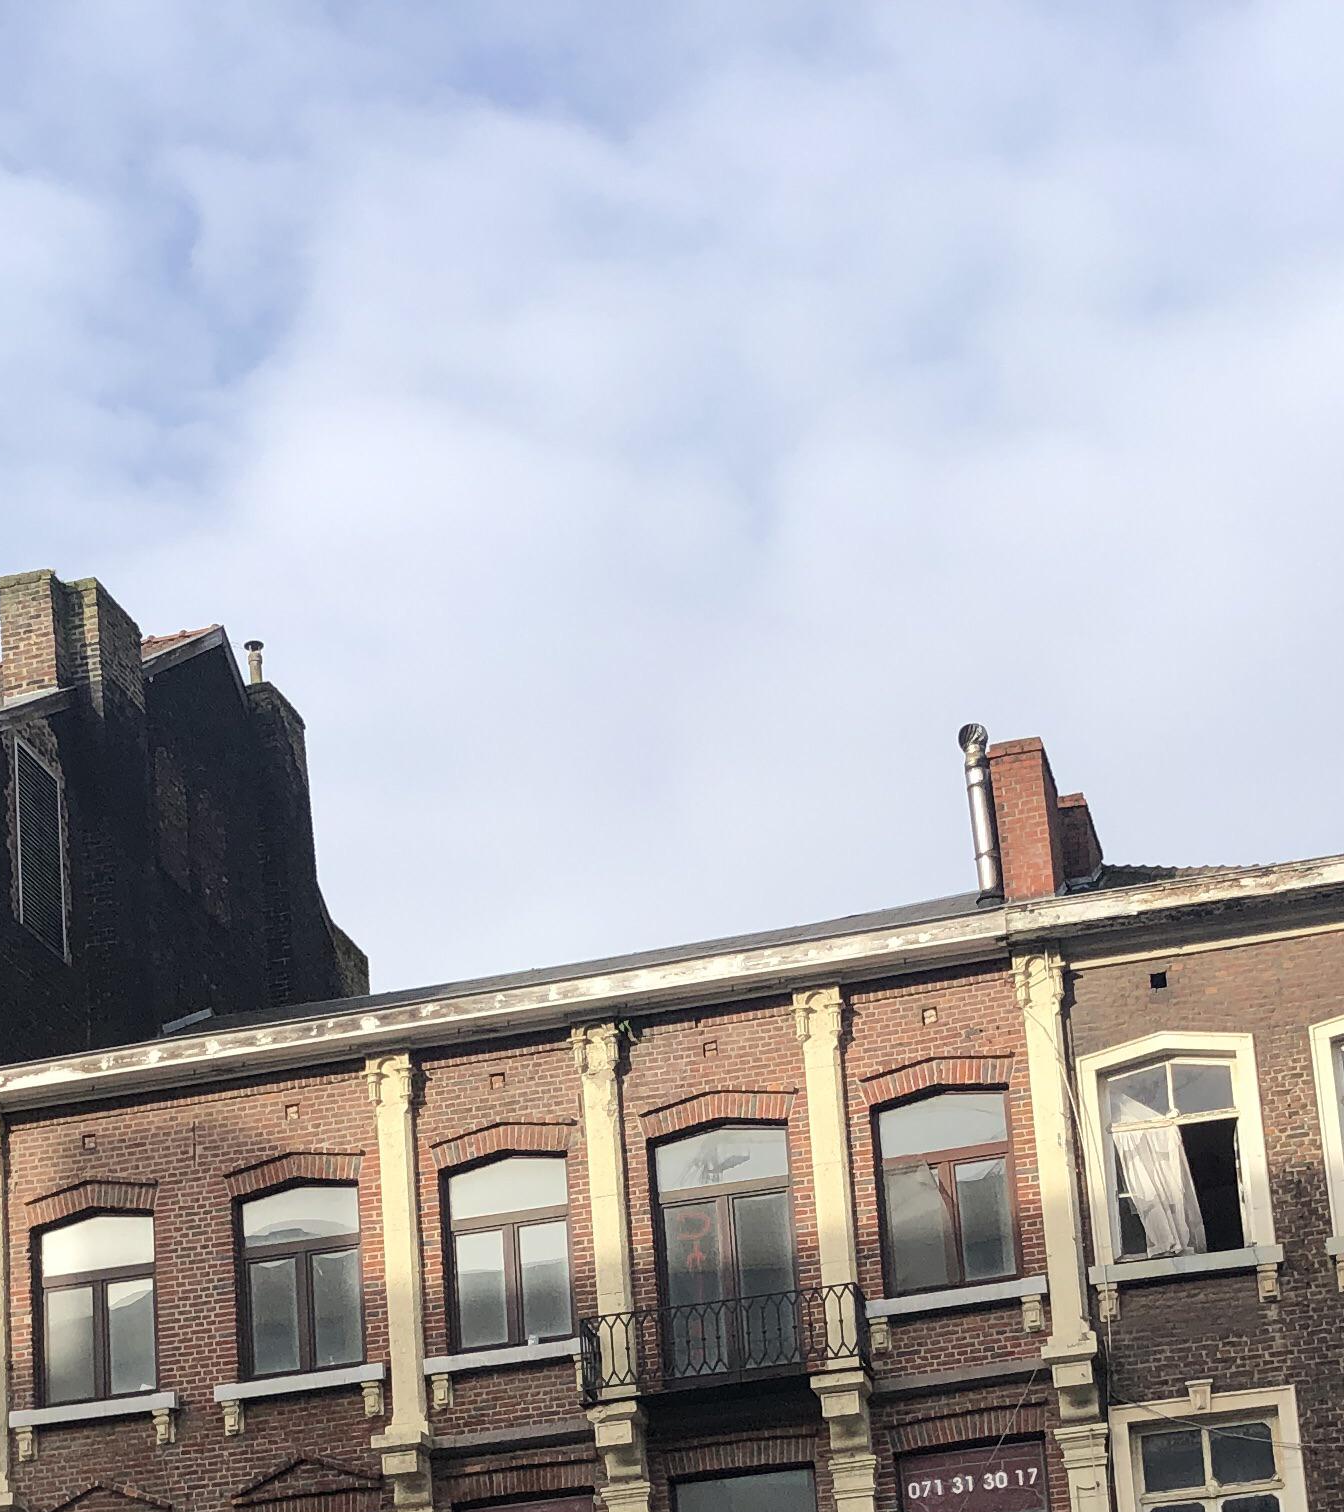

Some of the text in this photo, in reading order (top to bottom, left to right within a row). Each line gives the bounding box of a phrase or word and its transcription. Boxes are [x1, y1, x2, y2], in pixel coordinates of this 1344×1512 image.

[908, 1467, 1038, 1499] 071 31 30 17
